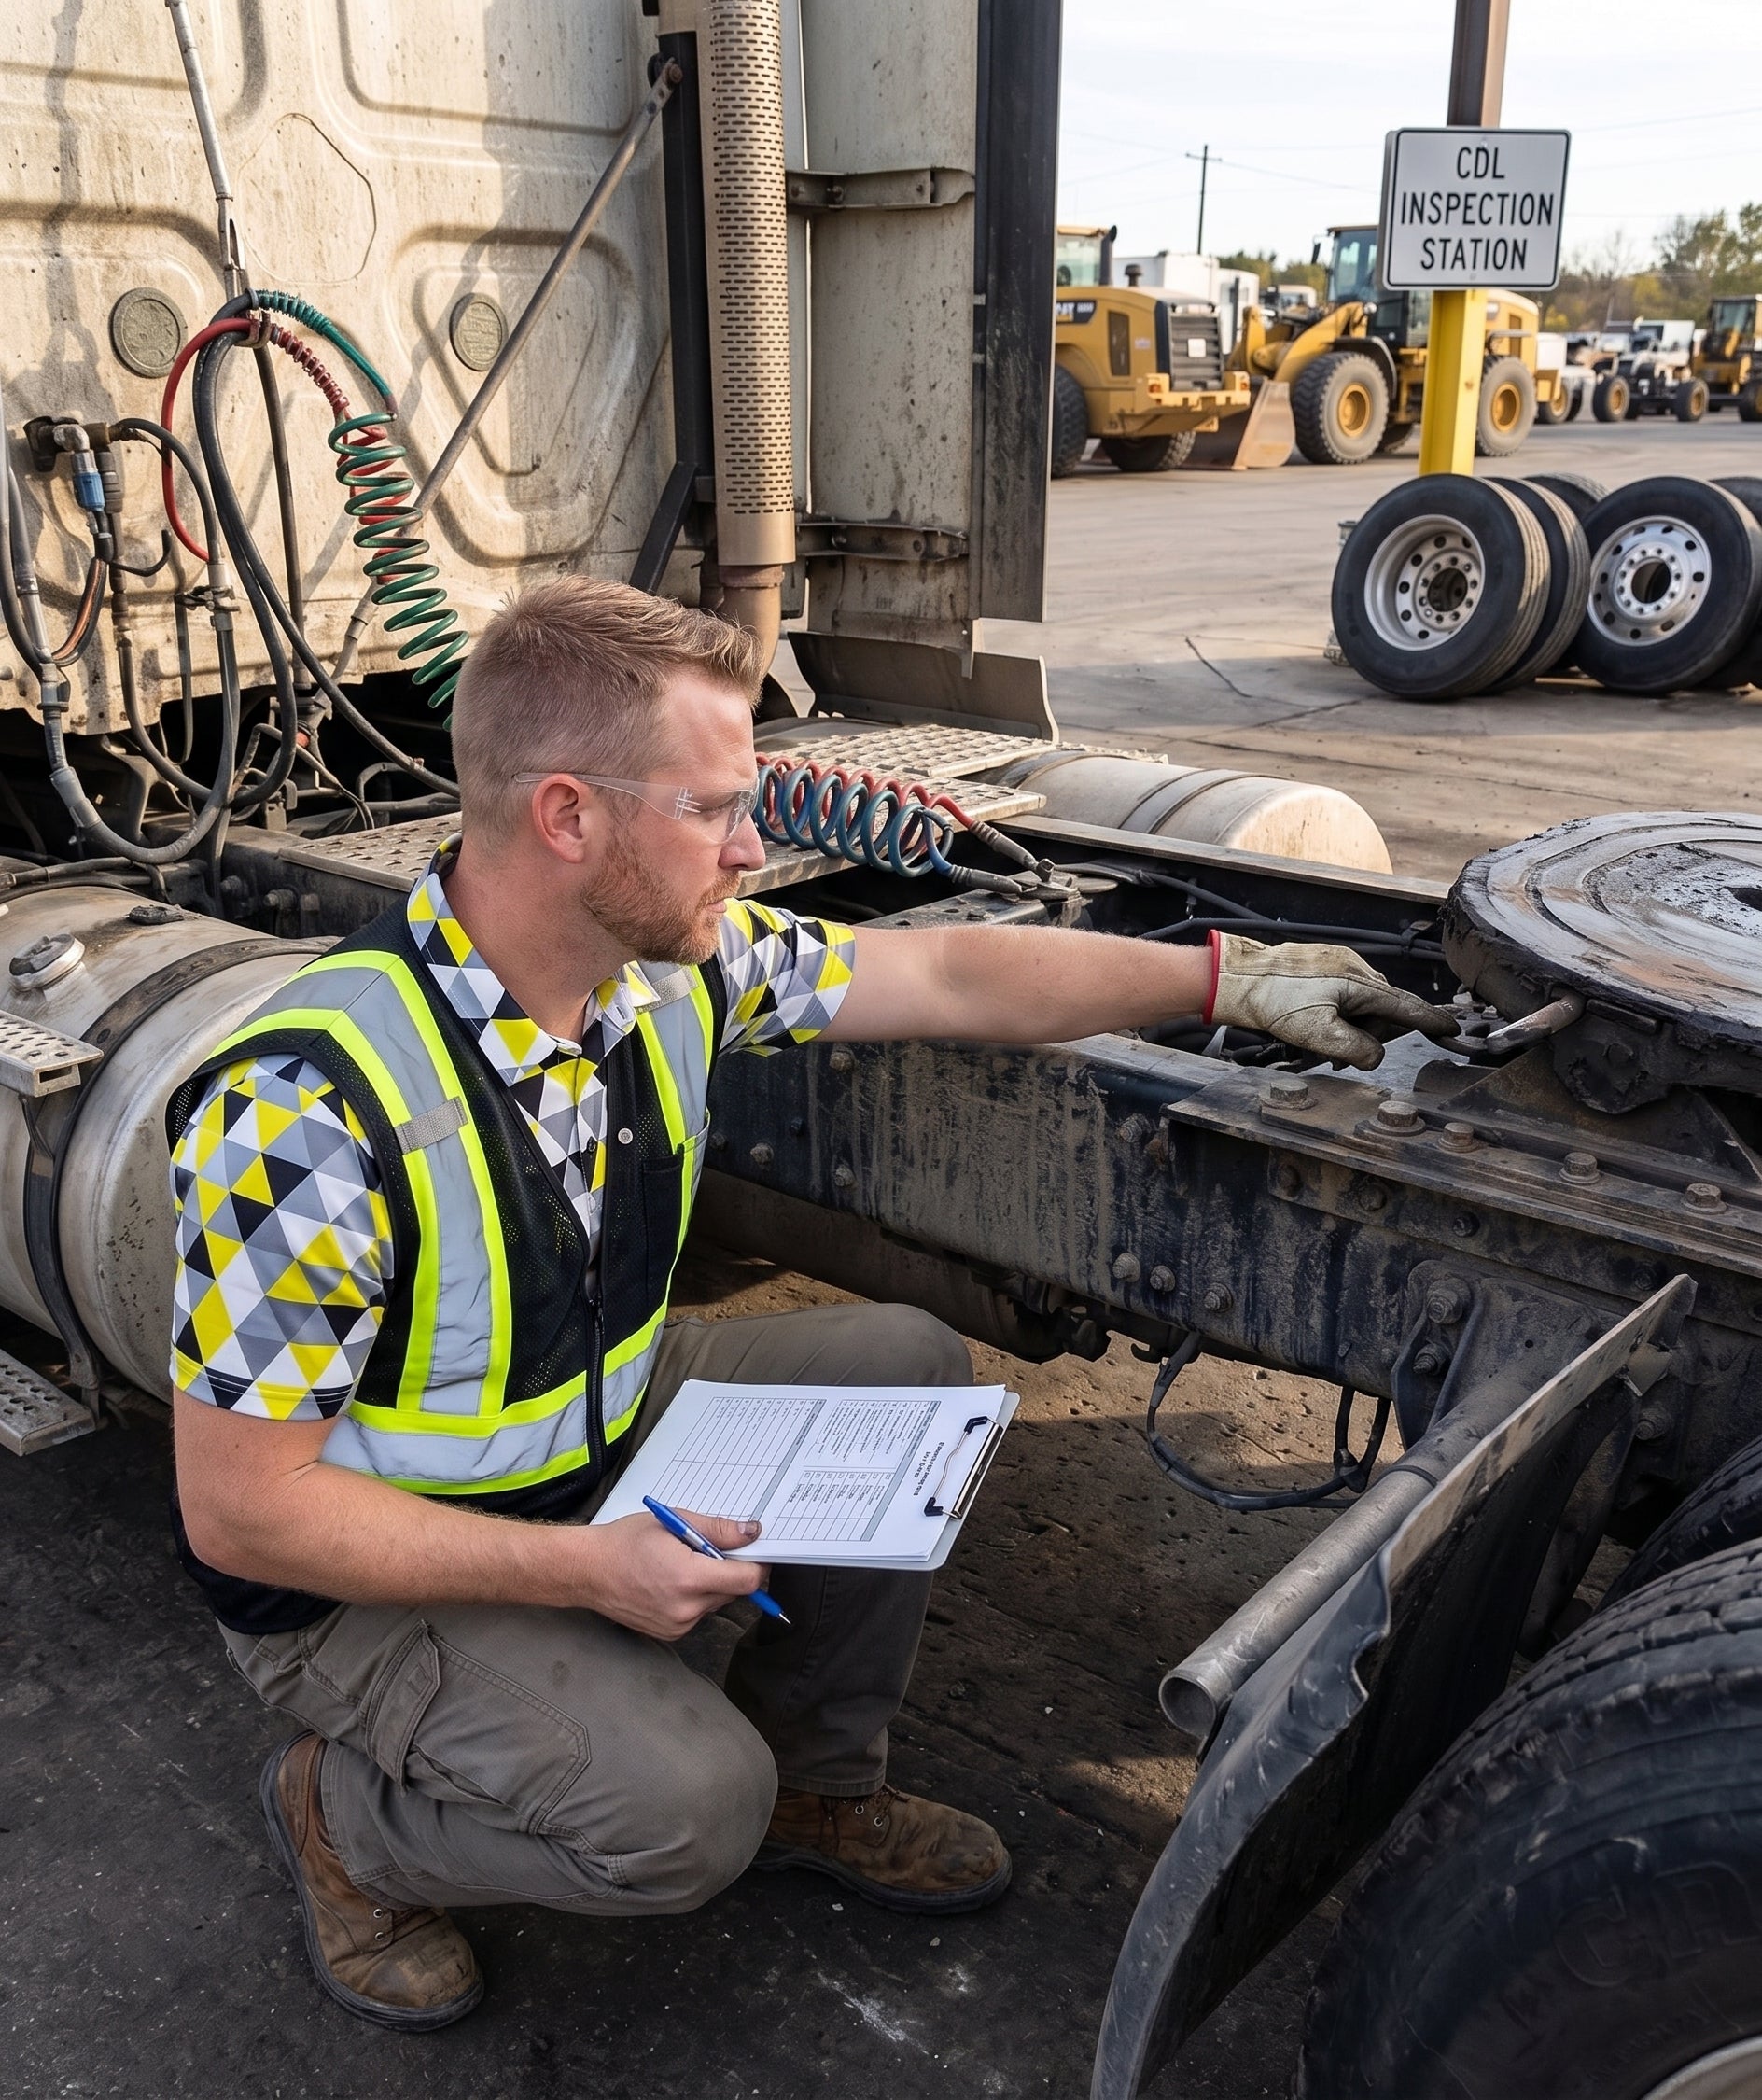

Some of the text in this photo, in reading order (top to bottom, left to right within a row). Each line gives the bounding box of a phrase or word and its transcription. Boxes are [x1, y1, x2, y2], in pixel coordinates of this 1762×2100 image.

[1456, 146, 1505, 179] CDL
[1401, 191, 1555, 227] INSPECTION
[1420, 237, 1528, 271] STATION
